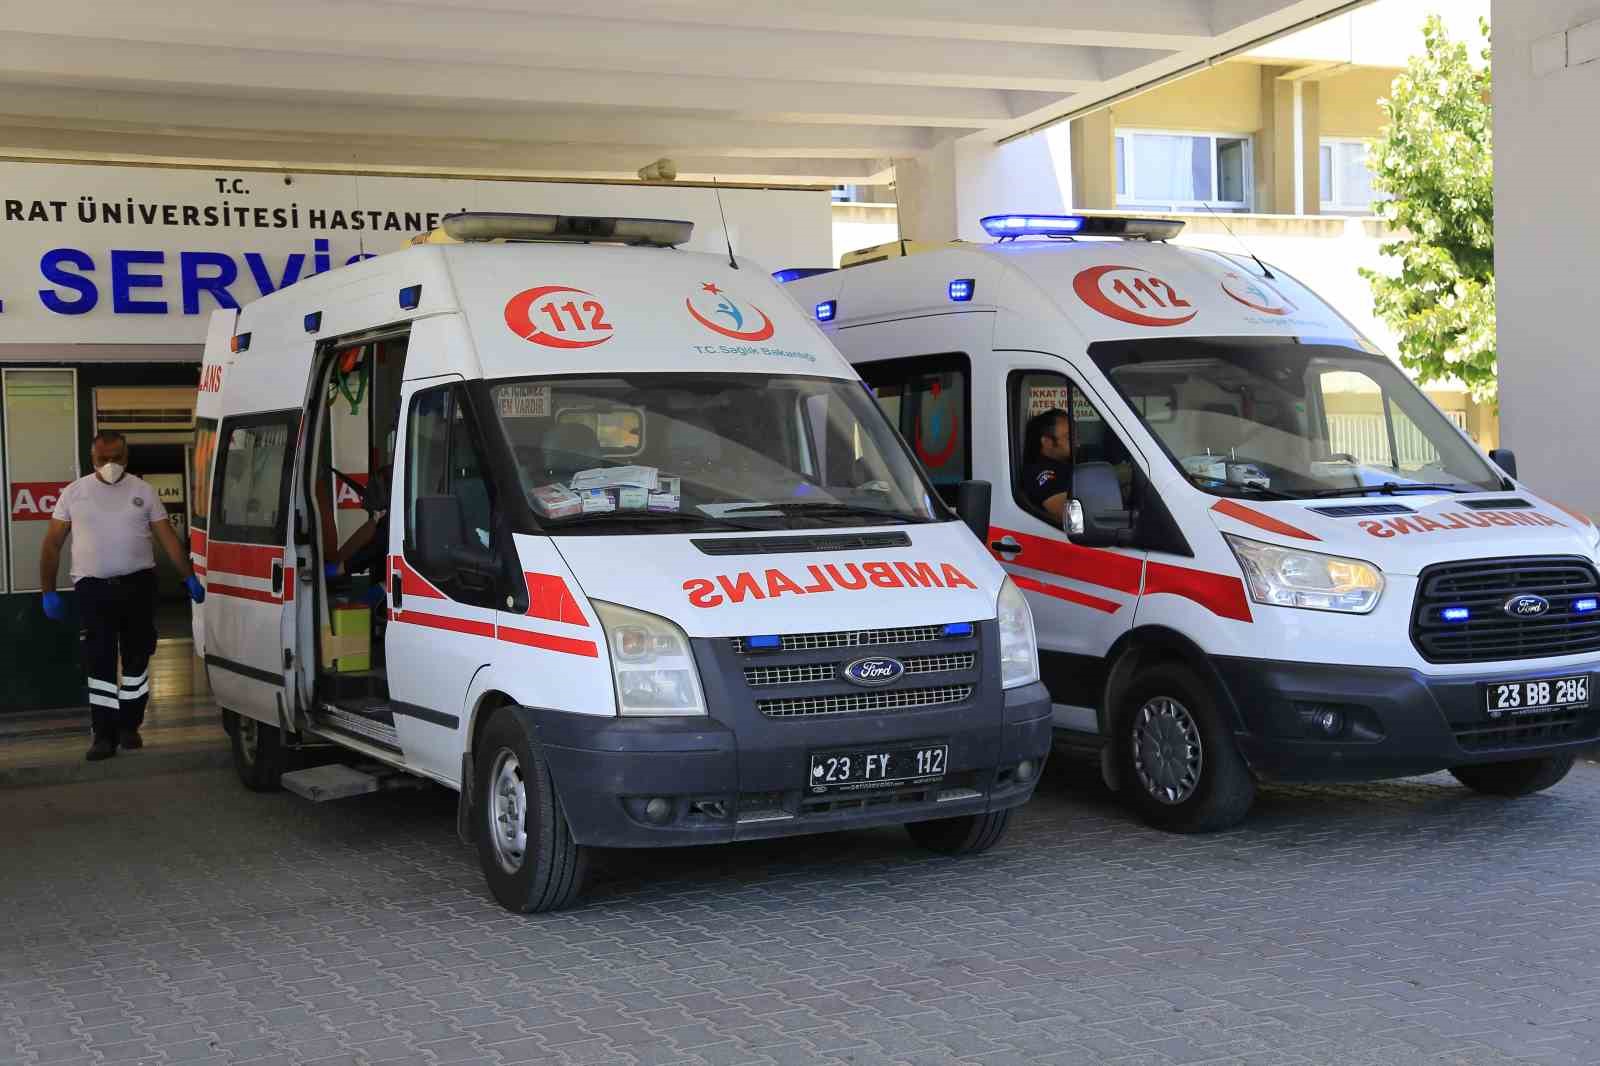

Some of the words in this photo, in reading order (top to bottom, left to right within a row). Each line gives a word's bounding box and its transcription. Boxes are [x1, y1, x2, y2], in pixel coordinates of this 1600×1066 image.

[215, 178, 250, 194] T.C.
[77, 196, 299, 229] ÜNİVERSİTESİ
[309, 207, 466, 232] HASTANE
[38, 238, 378, 315] SERVİ
[1113, 277, 1192, 308] 112
[540, 300, 614, 332] 112
[859, 660, 893, 678] Ford
[1497, 684, 1520, 708] 23
[1526, 682, 1550, 705] BB
[1555, 679, 1586, 703] 286
[825, 757, 851, 781] 23
[865, 753, 890, 779] FY
[916, 749, 943, 774] 112
